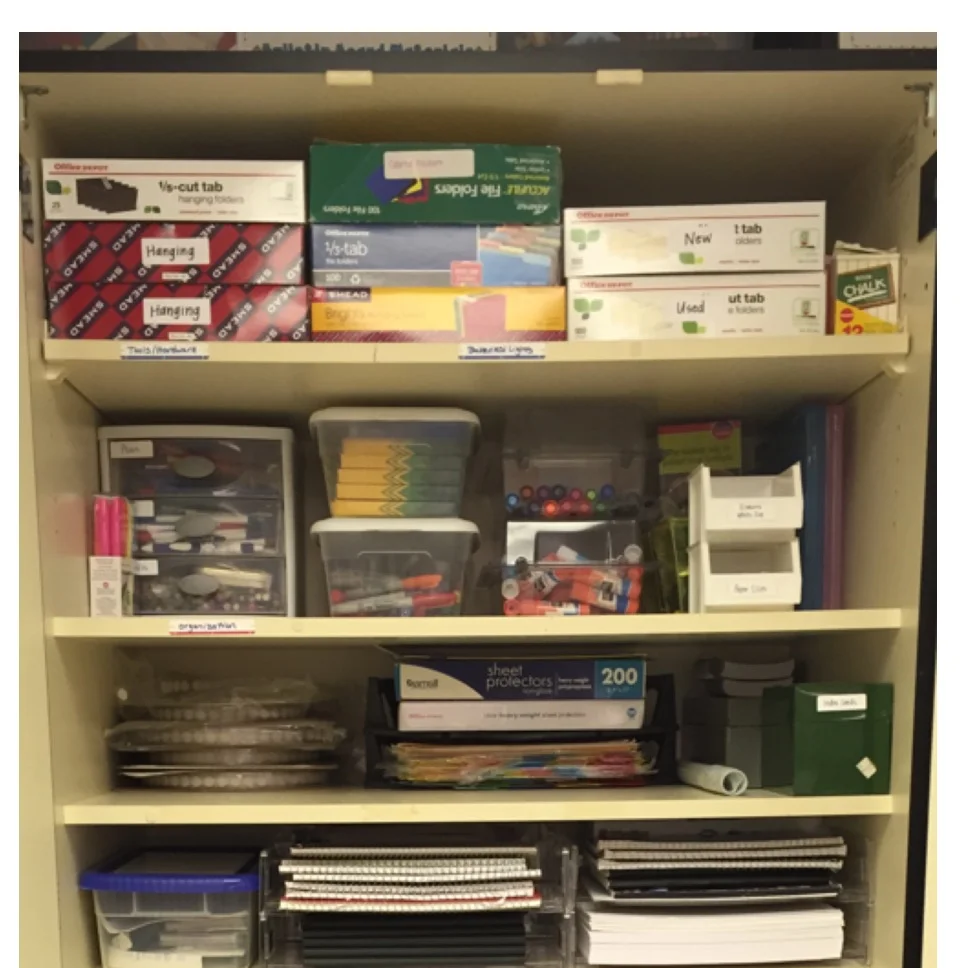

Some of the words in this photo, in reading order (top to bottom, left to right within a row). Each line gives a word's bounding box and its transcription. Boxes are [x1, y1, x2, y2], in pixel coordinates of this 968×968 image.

[202, 181, 223, 192] tab
[435, 184, 478, 197] Folders
[480, 184, 501, 197] File
[178, 194, 213, 205] hanging
[214, 194, 245, 204] folders
[323, 204, 351, 213] Folders
[742, 223, 763, 234] tab
[684, 231, 712, 246] New
[736, 236, 762, 246] olders
[63, 240, 99, 277] SMEAD
[145, 245, 195, 262] Hanging
[212, 242, 247, 278] SMEAD
[326, 273, 342, 283] 100
[329, 291, 369, 299] SMEAD
[843, 278, 888, 300] CHALK
[743, 292, 765, 304] tab
[150, 303, 200, 321] Hanging
[676, 301, 705, 315] Used
[735, 304, 765, 315] folders
[69, 301, 105, 337] SMEAD
[217, 302, 253, 339] SMEAD
[487, 662, 522, 677] sheet
[601, 668, 638, 685] 200
[486, 675, 553, 691] protectors
